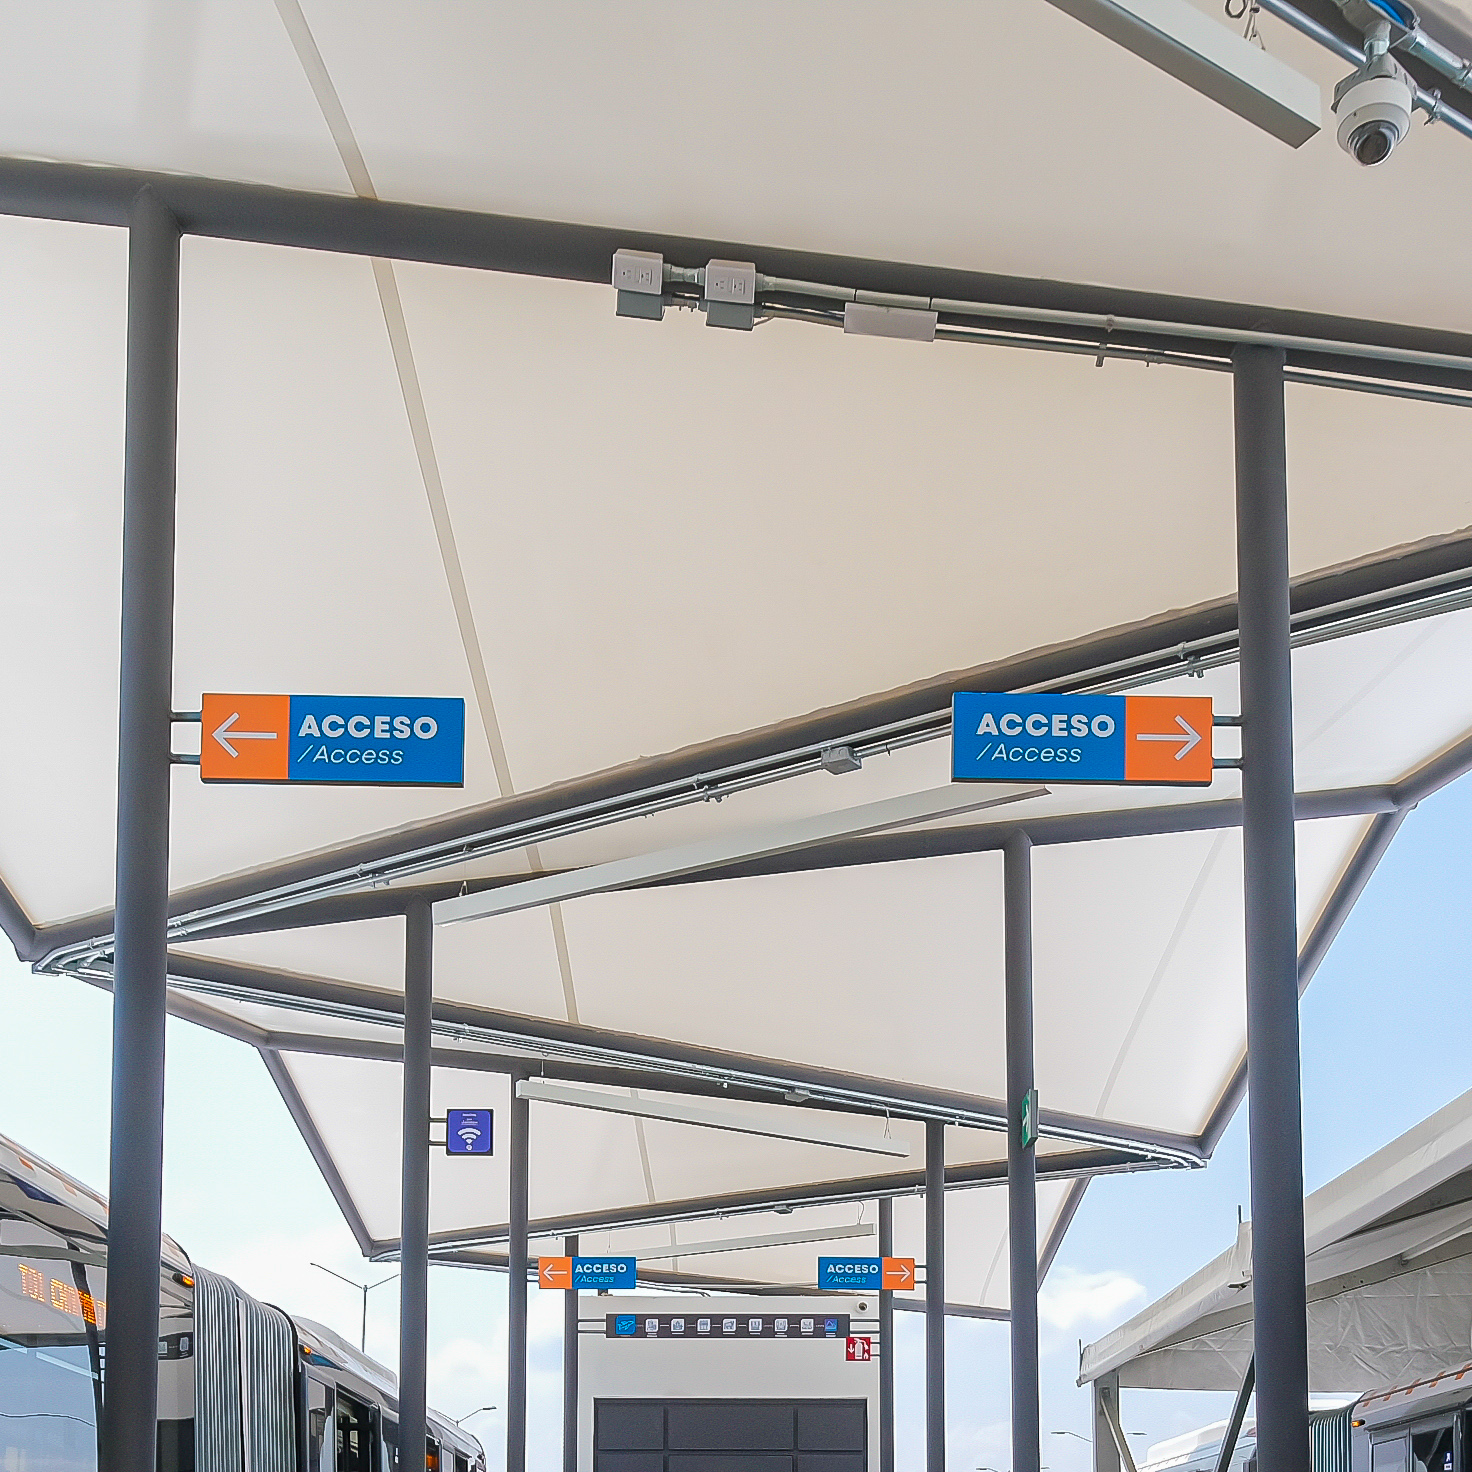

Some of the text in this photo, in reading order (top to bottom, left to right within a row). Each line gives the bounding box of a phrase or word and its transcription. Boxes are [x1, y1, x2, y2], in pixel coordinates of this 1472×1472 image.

[298, 715, 438, 739] ACCESO
[976, 713, 1115, 738] ACCESO
[297, 745, 404, 764] /Access
[976, 743, 1081, 762] /Access
[575, 1264, 626, 1273] ACCESO
[827, 1264, 878, 1274] ACCESO
